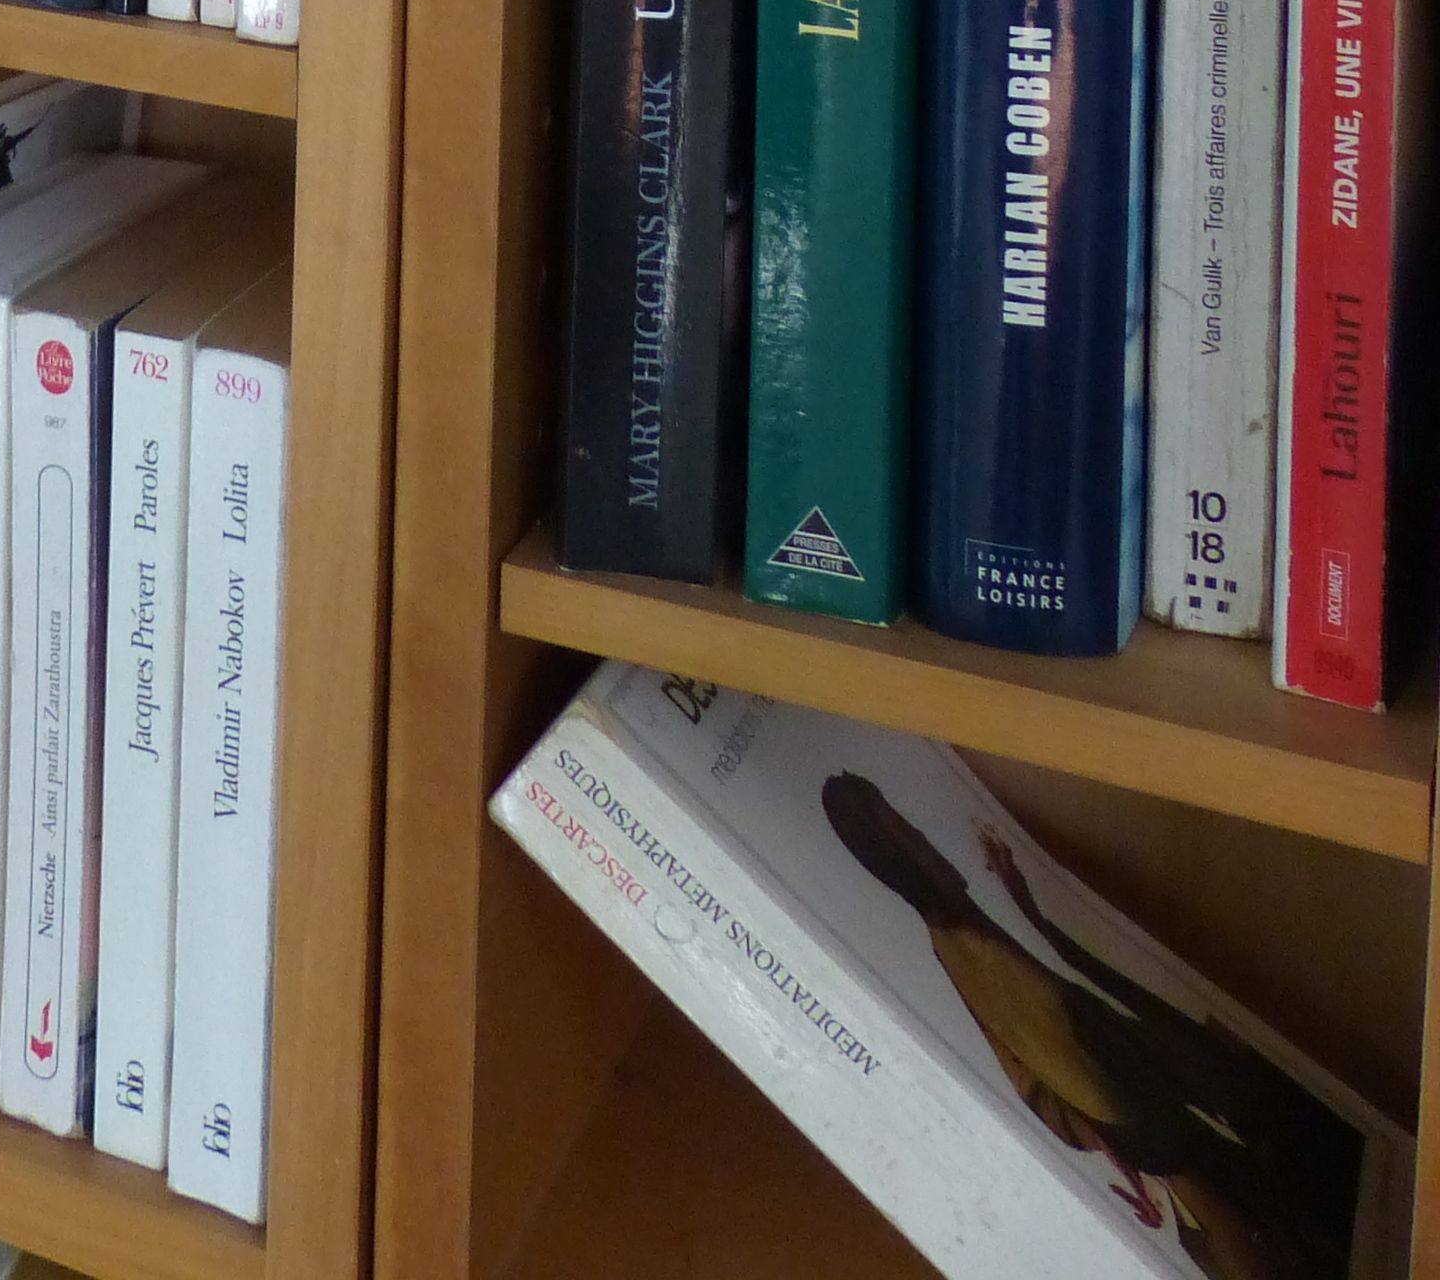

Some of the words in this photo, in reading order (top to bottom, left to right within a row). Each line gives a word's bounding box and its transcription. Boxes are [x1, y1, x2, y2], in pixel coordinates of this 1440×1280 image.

[1006, 25, 1052, 156] COBEN
[1335, 39, 1362, 98] UNE
[639, 70, 674, 204] CLARK
[1205, 104, 1229, 180] affaires
[1331, 108, 1365, 229] ZIDANE,
[1002, 171, 1050, 327] HARLAN
[1203, 185, 1225, 232] Trois
[632, 214, 669, 384] HIGGINS
[1200, 315, 1223, 356] Van
[1201, 257, 1224, 310] Gulik
[133, 439, 160, 534] Paroles
[222, 463, 250, 545] Lolita
[629, 394, 663, 509] MARY
[130, 559, 159, 650] Prévert
[217, 568, 248, 696] Nabokov
[128, 658, 161, 762] Jacques
[213, 702, 242, 819] Vladimir
[524, 781, 649, 906] DESCARTES
[554, 748, 731, 924] MÉTAPHYSIQUES
[36, 851, 57, 939] Nietzsche
[722, 919, 883, 1077] MÉDITATIONS
